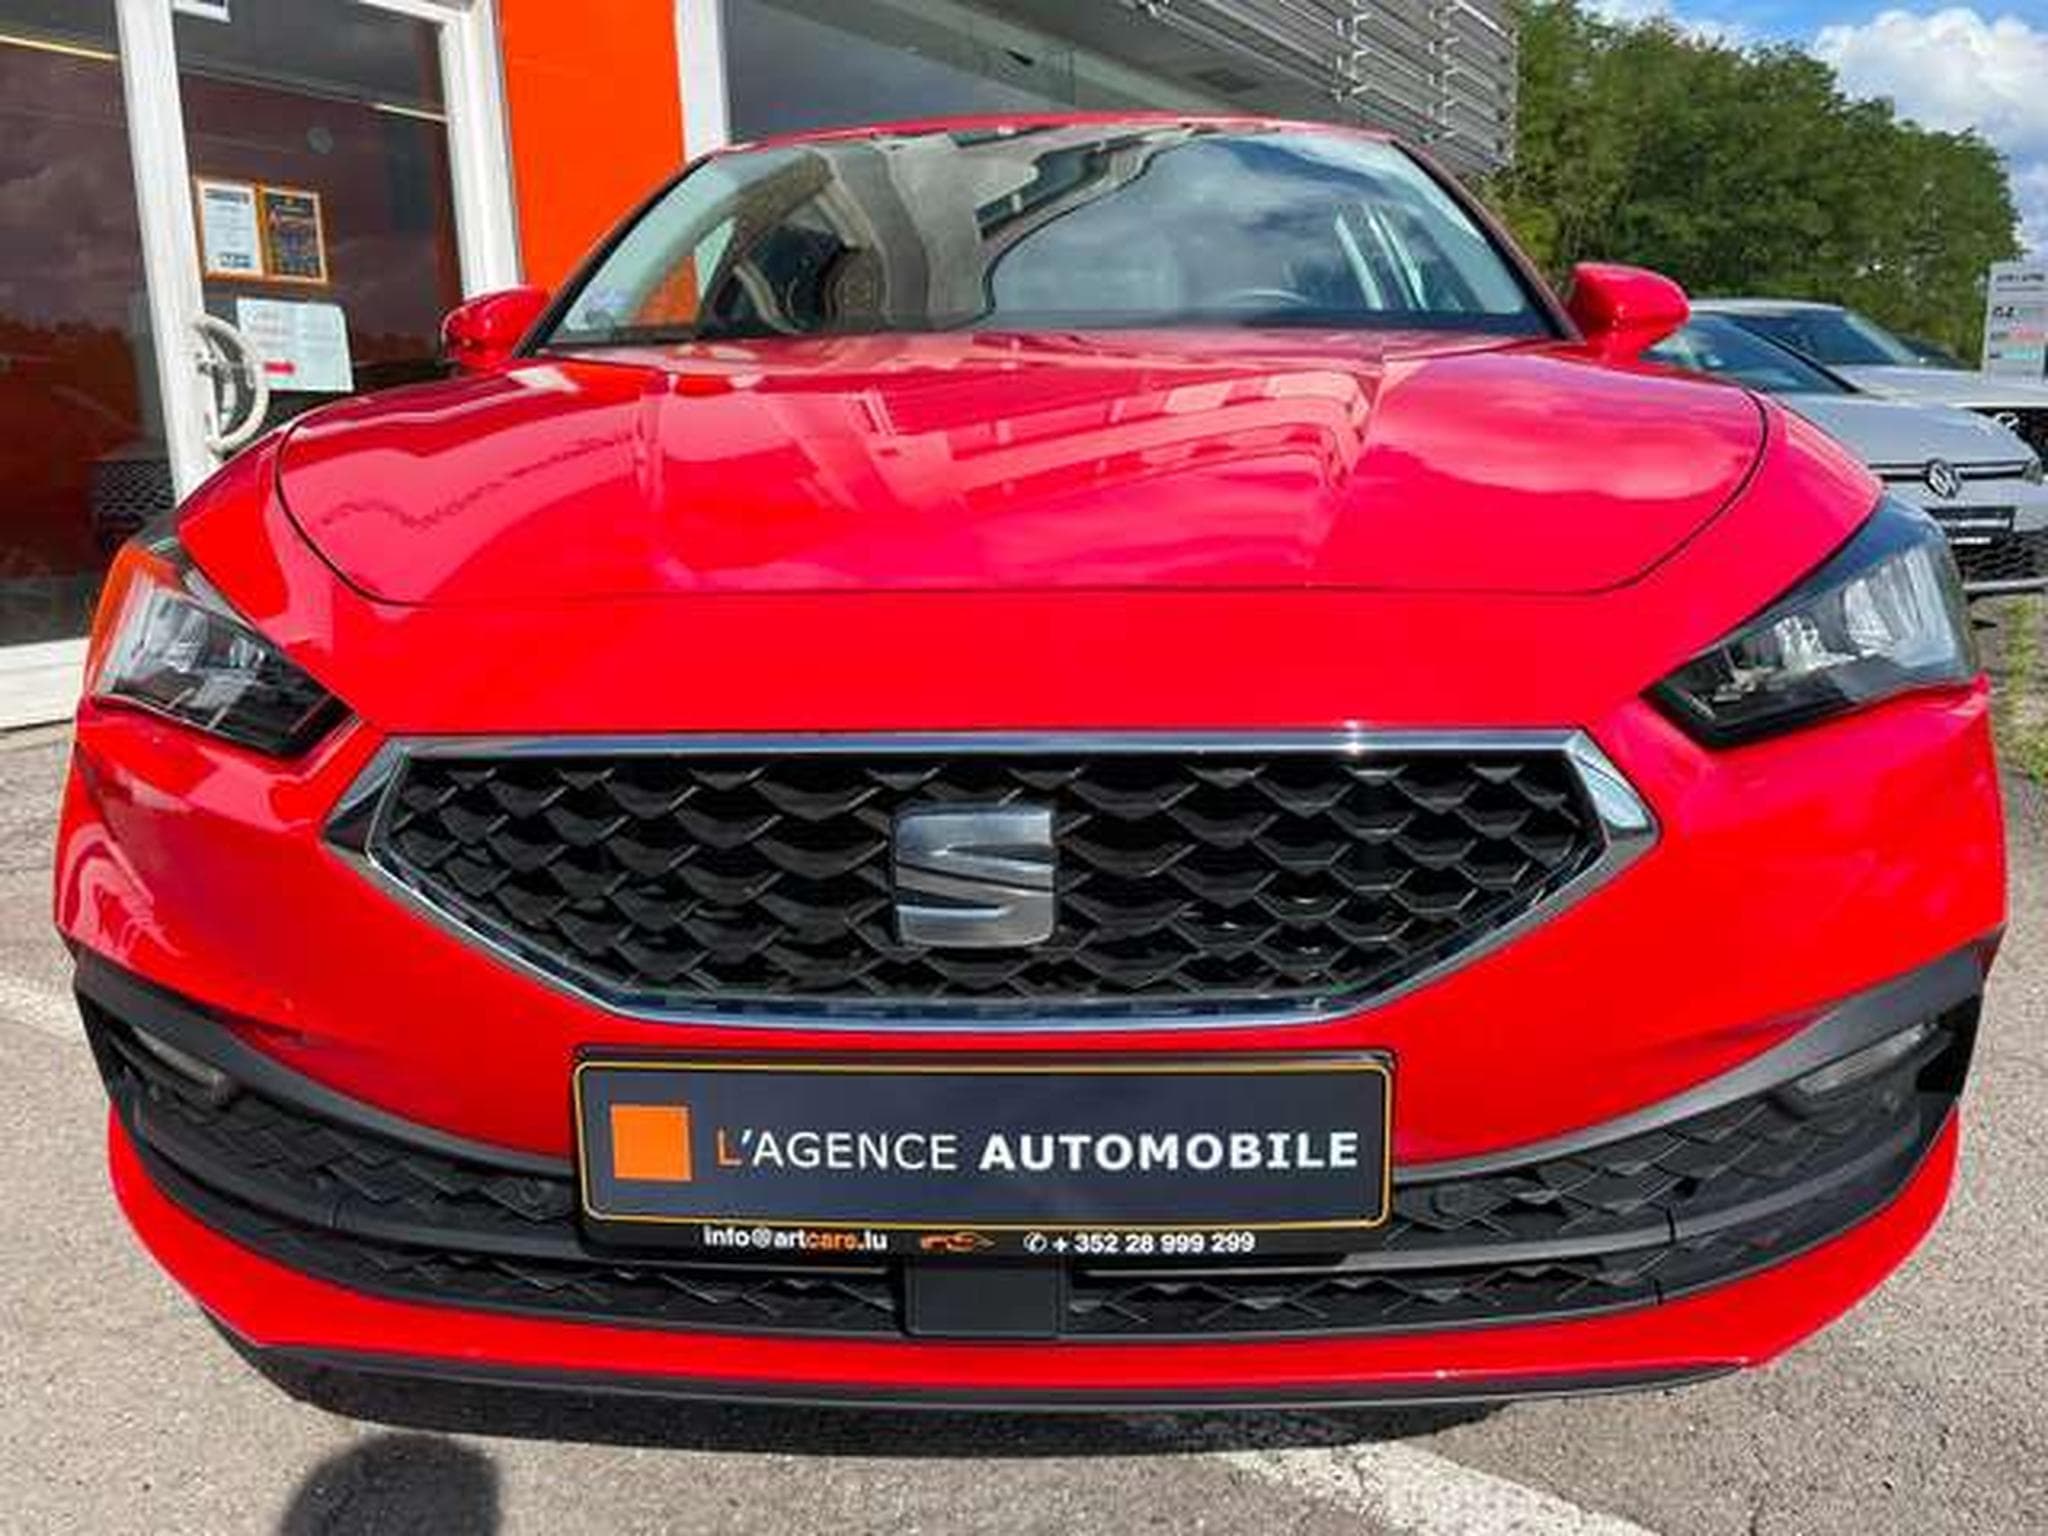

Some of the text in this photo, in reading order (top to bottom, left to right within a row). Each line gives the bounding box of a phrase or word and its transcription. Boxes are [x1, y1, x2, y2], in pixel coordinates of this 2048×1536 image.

[717, 1129, 1359, 1170] L’AGENCE AUTOMOBILE
[1073, 1232, 1119, 1253] 352
[1125, 1232, 1155, 1253] 28
[1160, 1233, 1205, 1254] 999
[1210, 1231, 1256, 1253] 299
